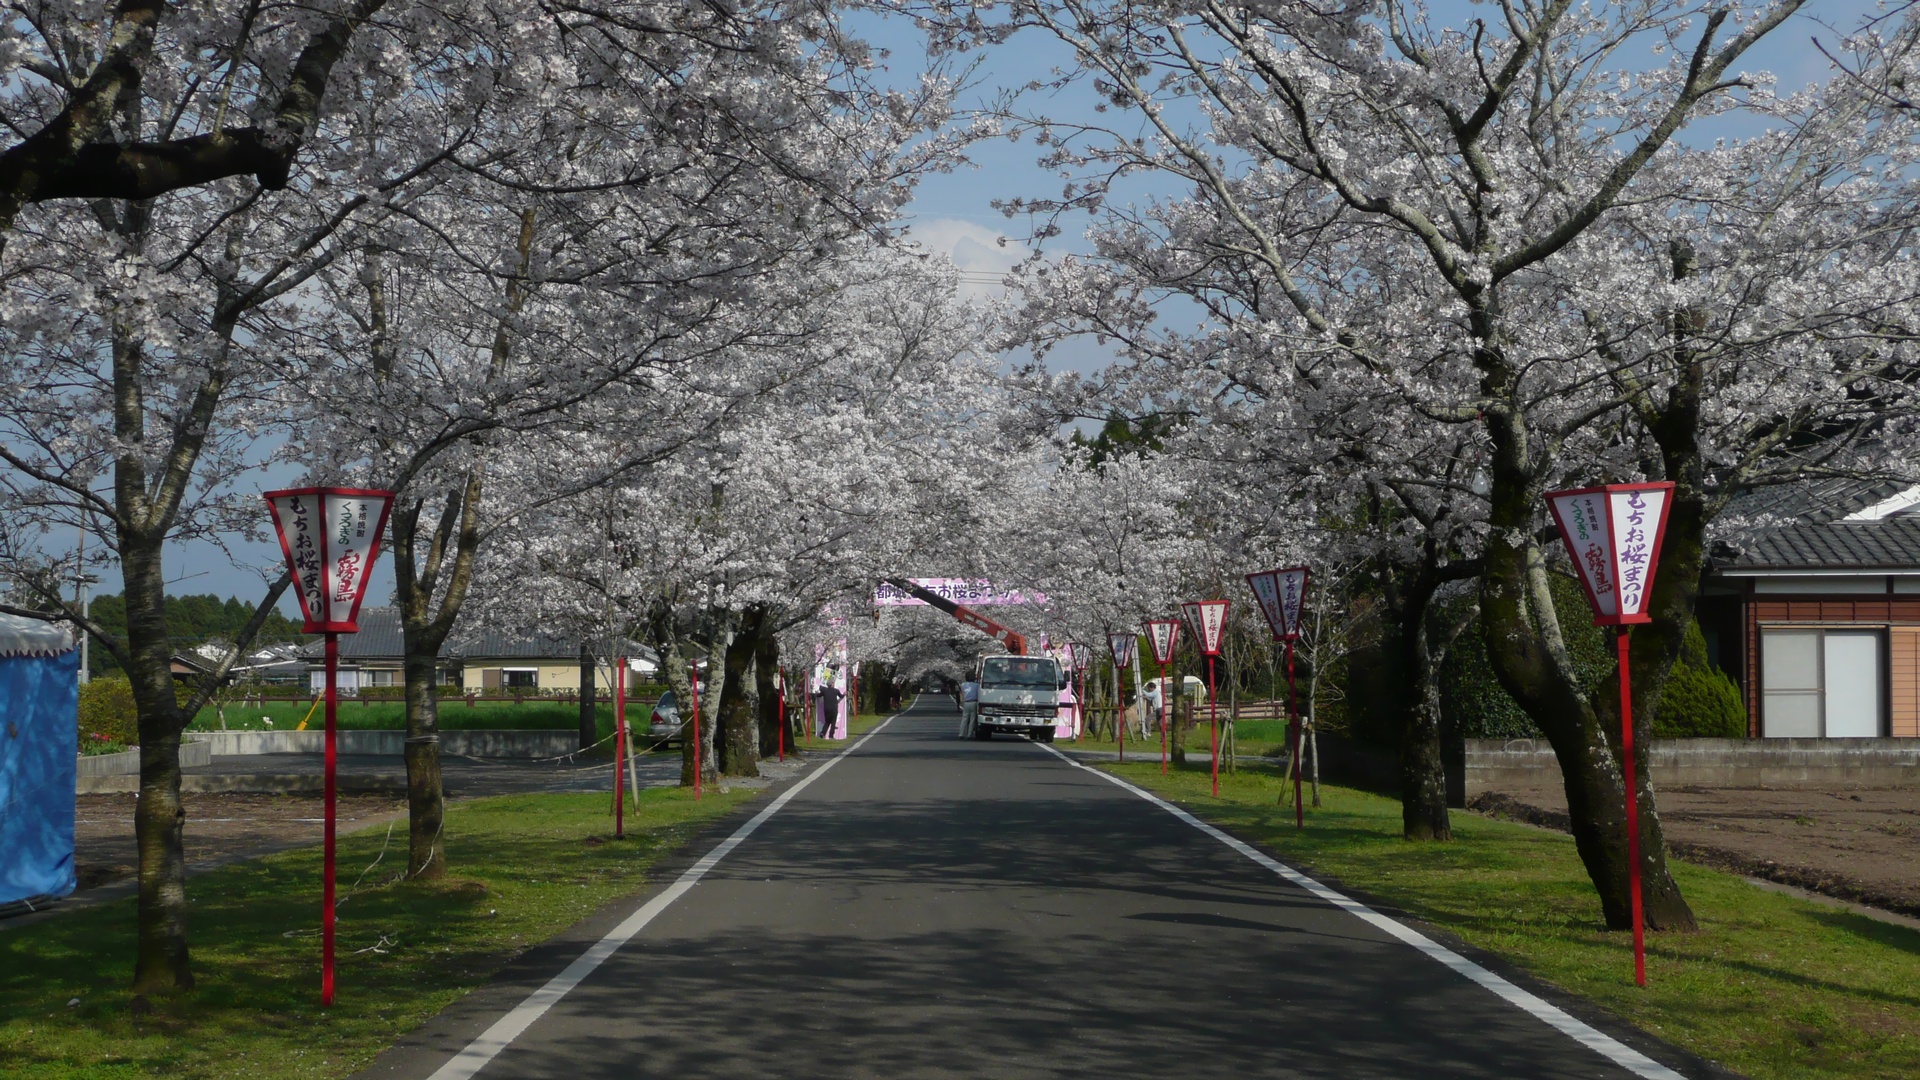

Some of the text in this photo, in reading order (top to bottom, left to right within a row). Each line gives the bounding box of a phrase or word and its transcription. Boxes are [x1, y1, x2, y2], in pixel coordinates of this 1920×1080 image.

[334, 501, 360, 603] くつろぎの 霧島
[356, 504, 368, 538] 本格焼酎
[1570, 499, 1613, 595] くつろぎの 霧島
[1584, 499, 1599, 531] 本格焼酎
[1620, 490, 1649, 608] もちお桜まつり
[289, 496, 323, 615] もちお桜まつり
[877, 583, 1010, 599] 都城ちお桜まつ
[1284, 573, 1299, 632] もちお桜まつり
